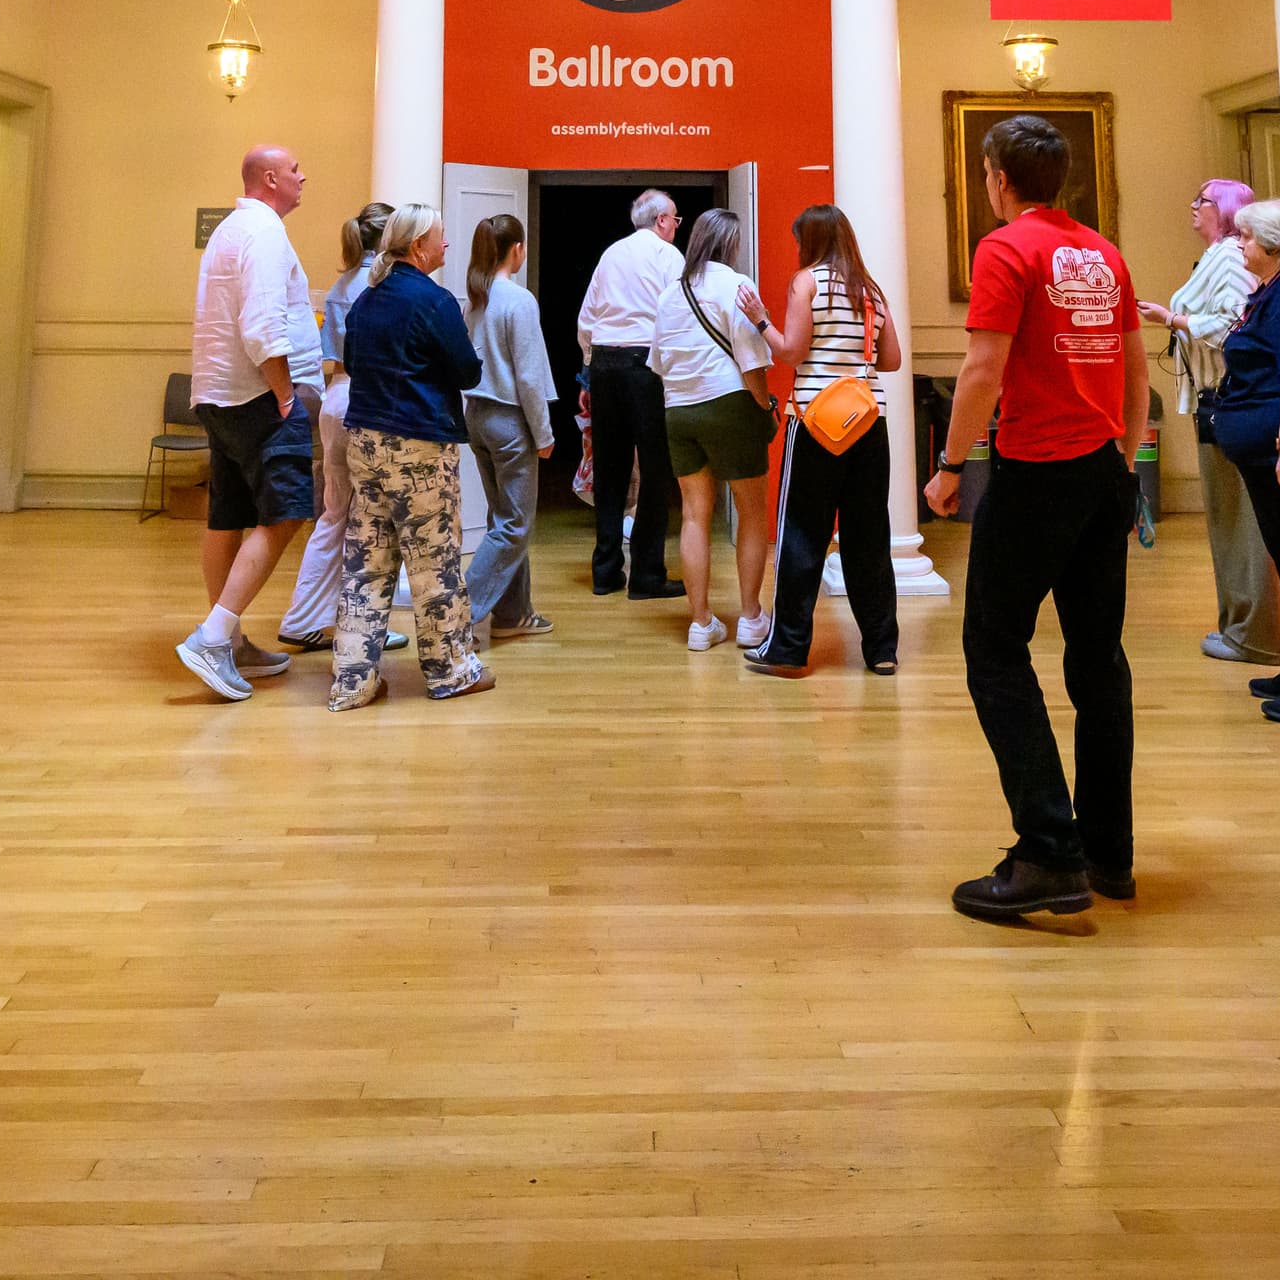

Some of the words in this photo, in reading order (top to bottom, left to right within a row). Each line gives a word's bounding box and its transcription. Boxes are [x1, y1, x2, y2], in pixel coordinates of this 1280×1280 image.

[528, 44, 734, 88] Ballroom
[551, 121, 710, 138] assemblyfestival.com
[1064, 295, 1108, 307] assembly
